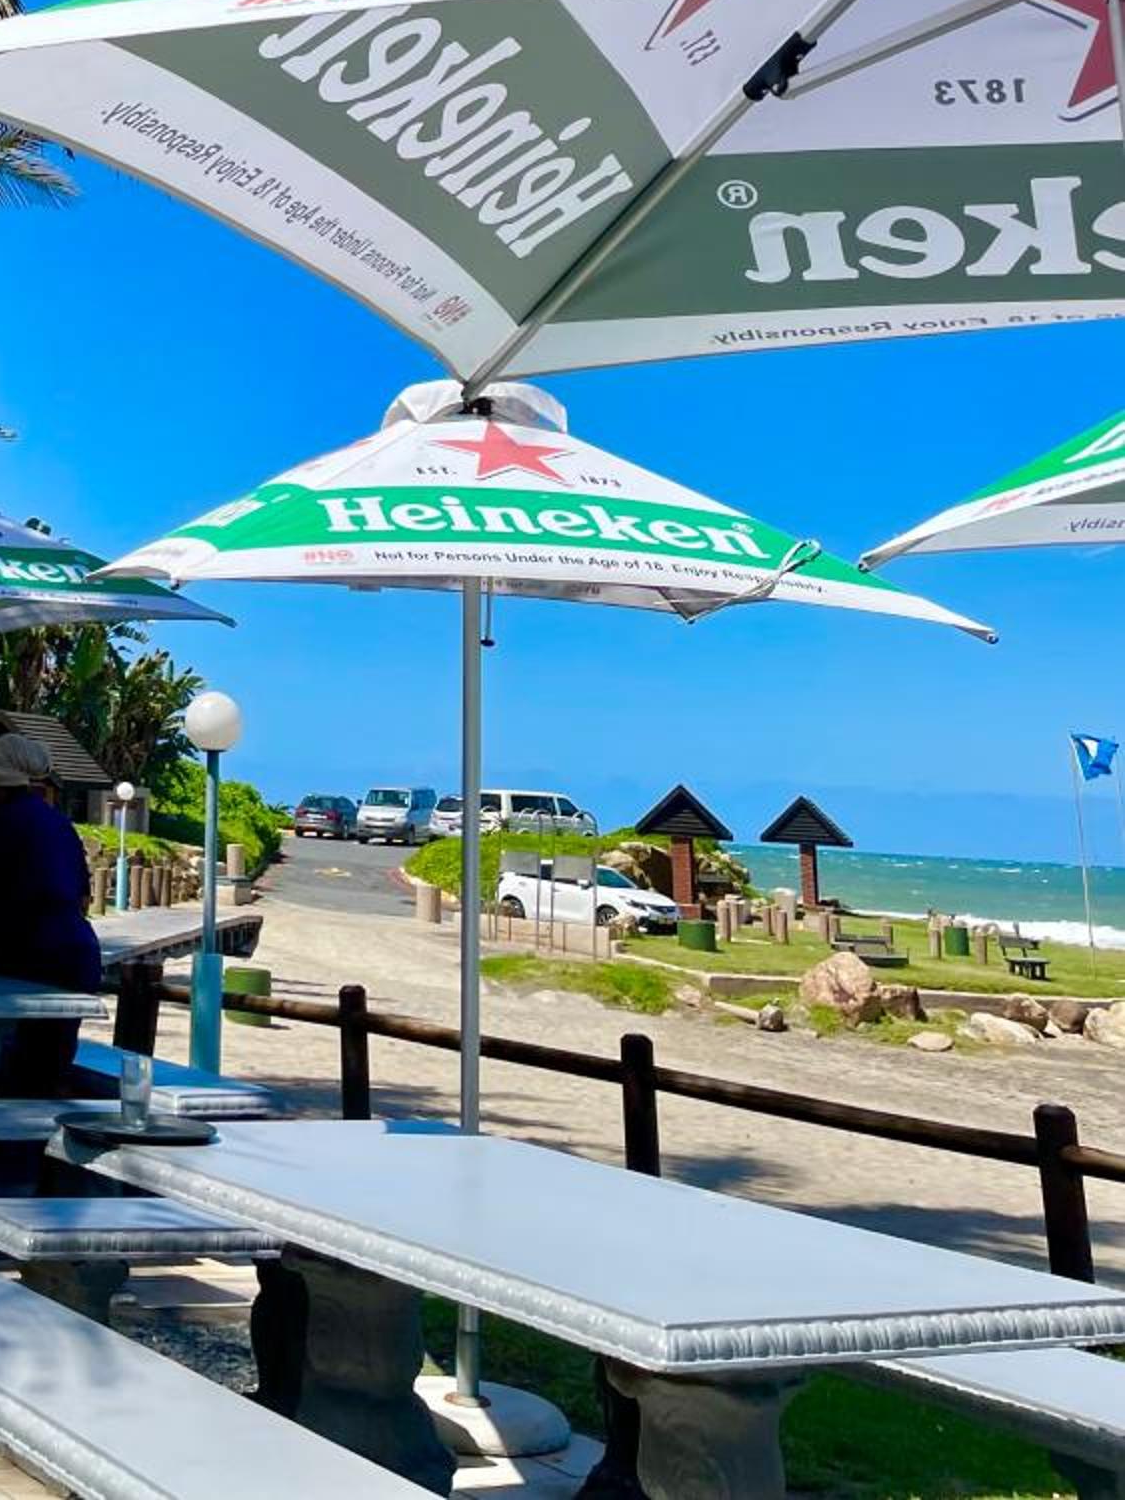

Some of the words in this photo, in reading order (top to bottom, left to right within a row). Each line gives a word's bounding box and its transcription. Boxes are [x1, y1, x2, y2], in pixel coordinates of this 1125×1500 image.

[434, 551, 501, 562] Persons
[504, 552, 553, 564] Under
[559, 554, 584, 565] the
[588, 556, 619, 569] Age
[624, 559, 641, 570] of
